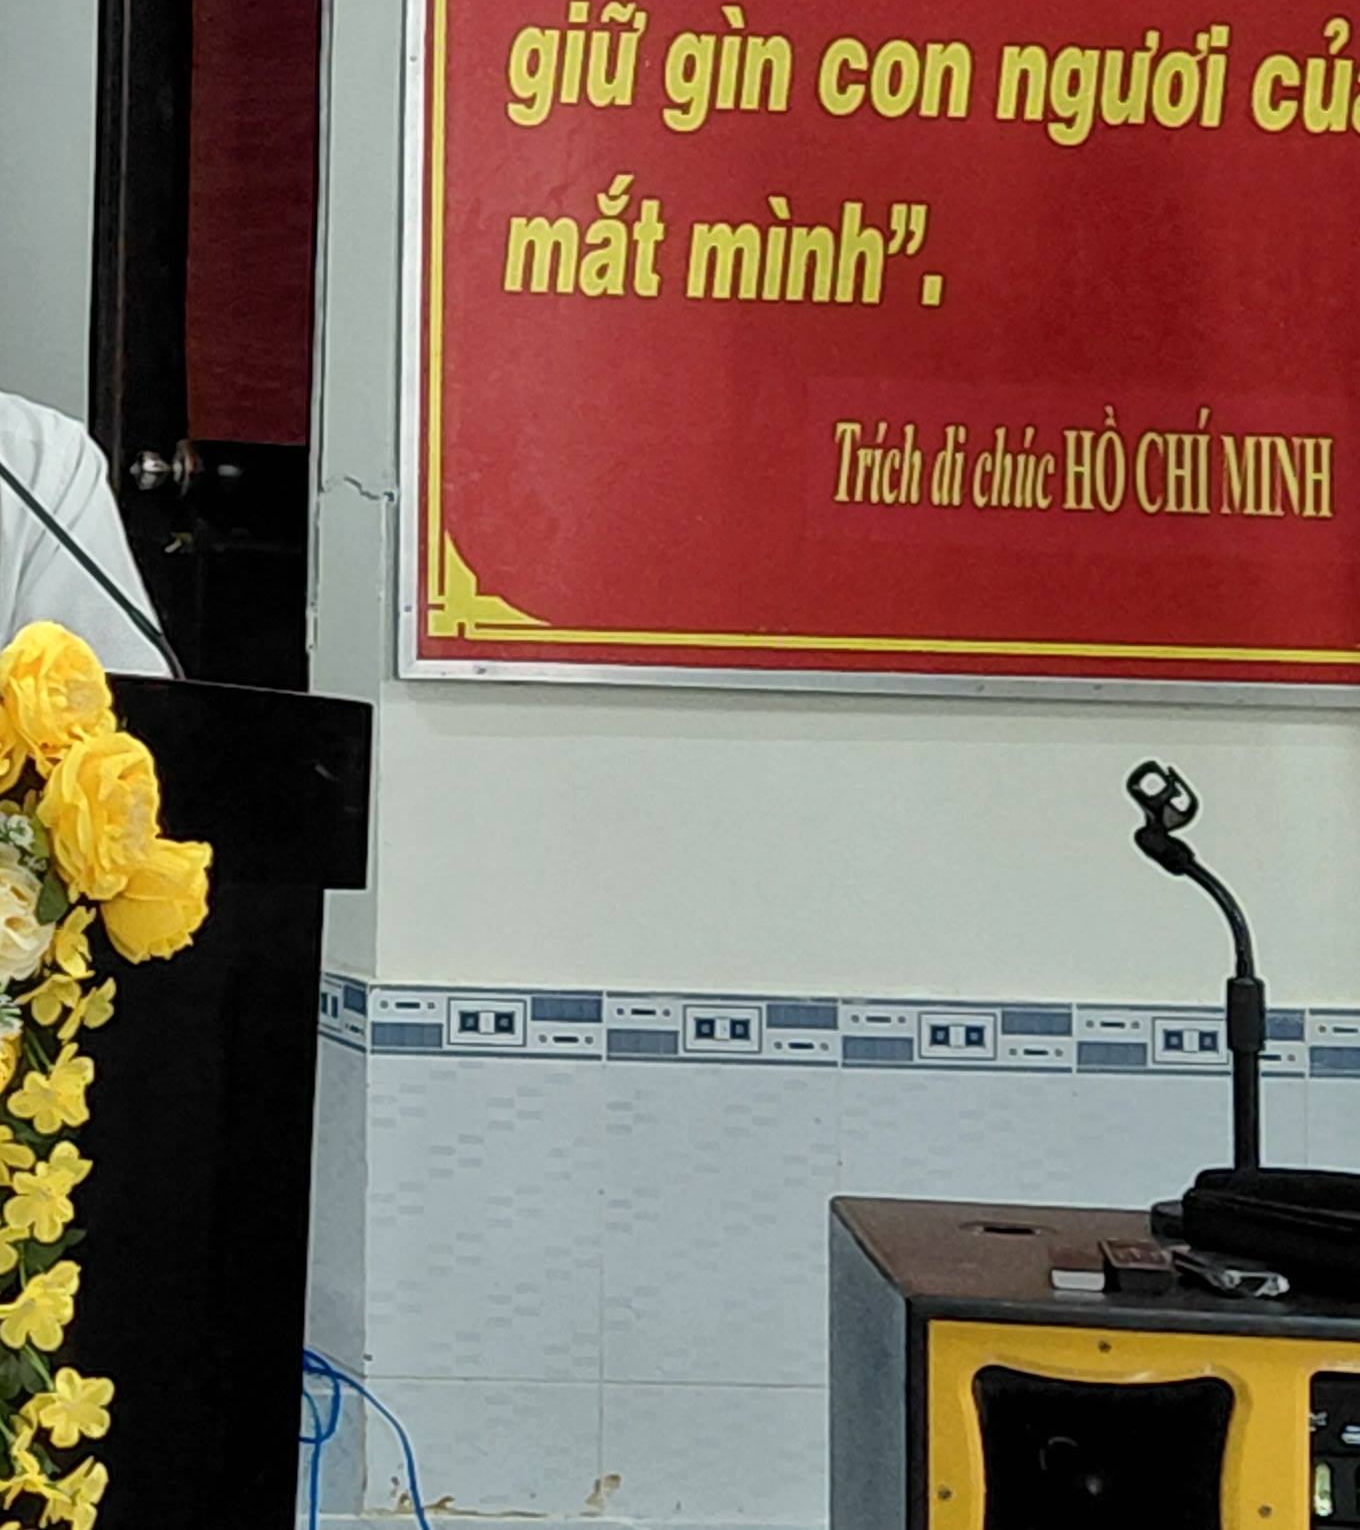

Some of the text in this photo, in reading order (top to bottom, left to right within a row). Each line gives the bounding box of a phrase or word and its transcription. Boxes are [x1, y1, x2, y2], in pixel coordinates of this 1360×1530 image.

[505, 0, 1360, 147] giữ gìn con ngươi củ
[502, 172, 667, 298] mắt
[833, 404, 1334, 518] Trích di chúc HỒ CHÍ MINH
